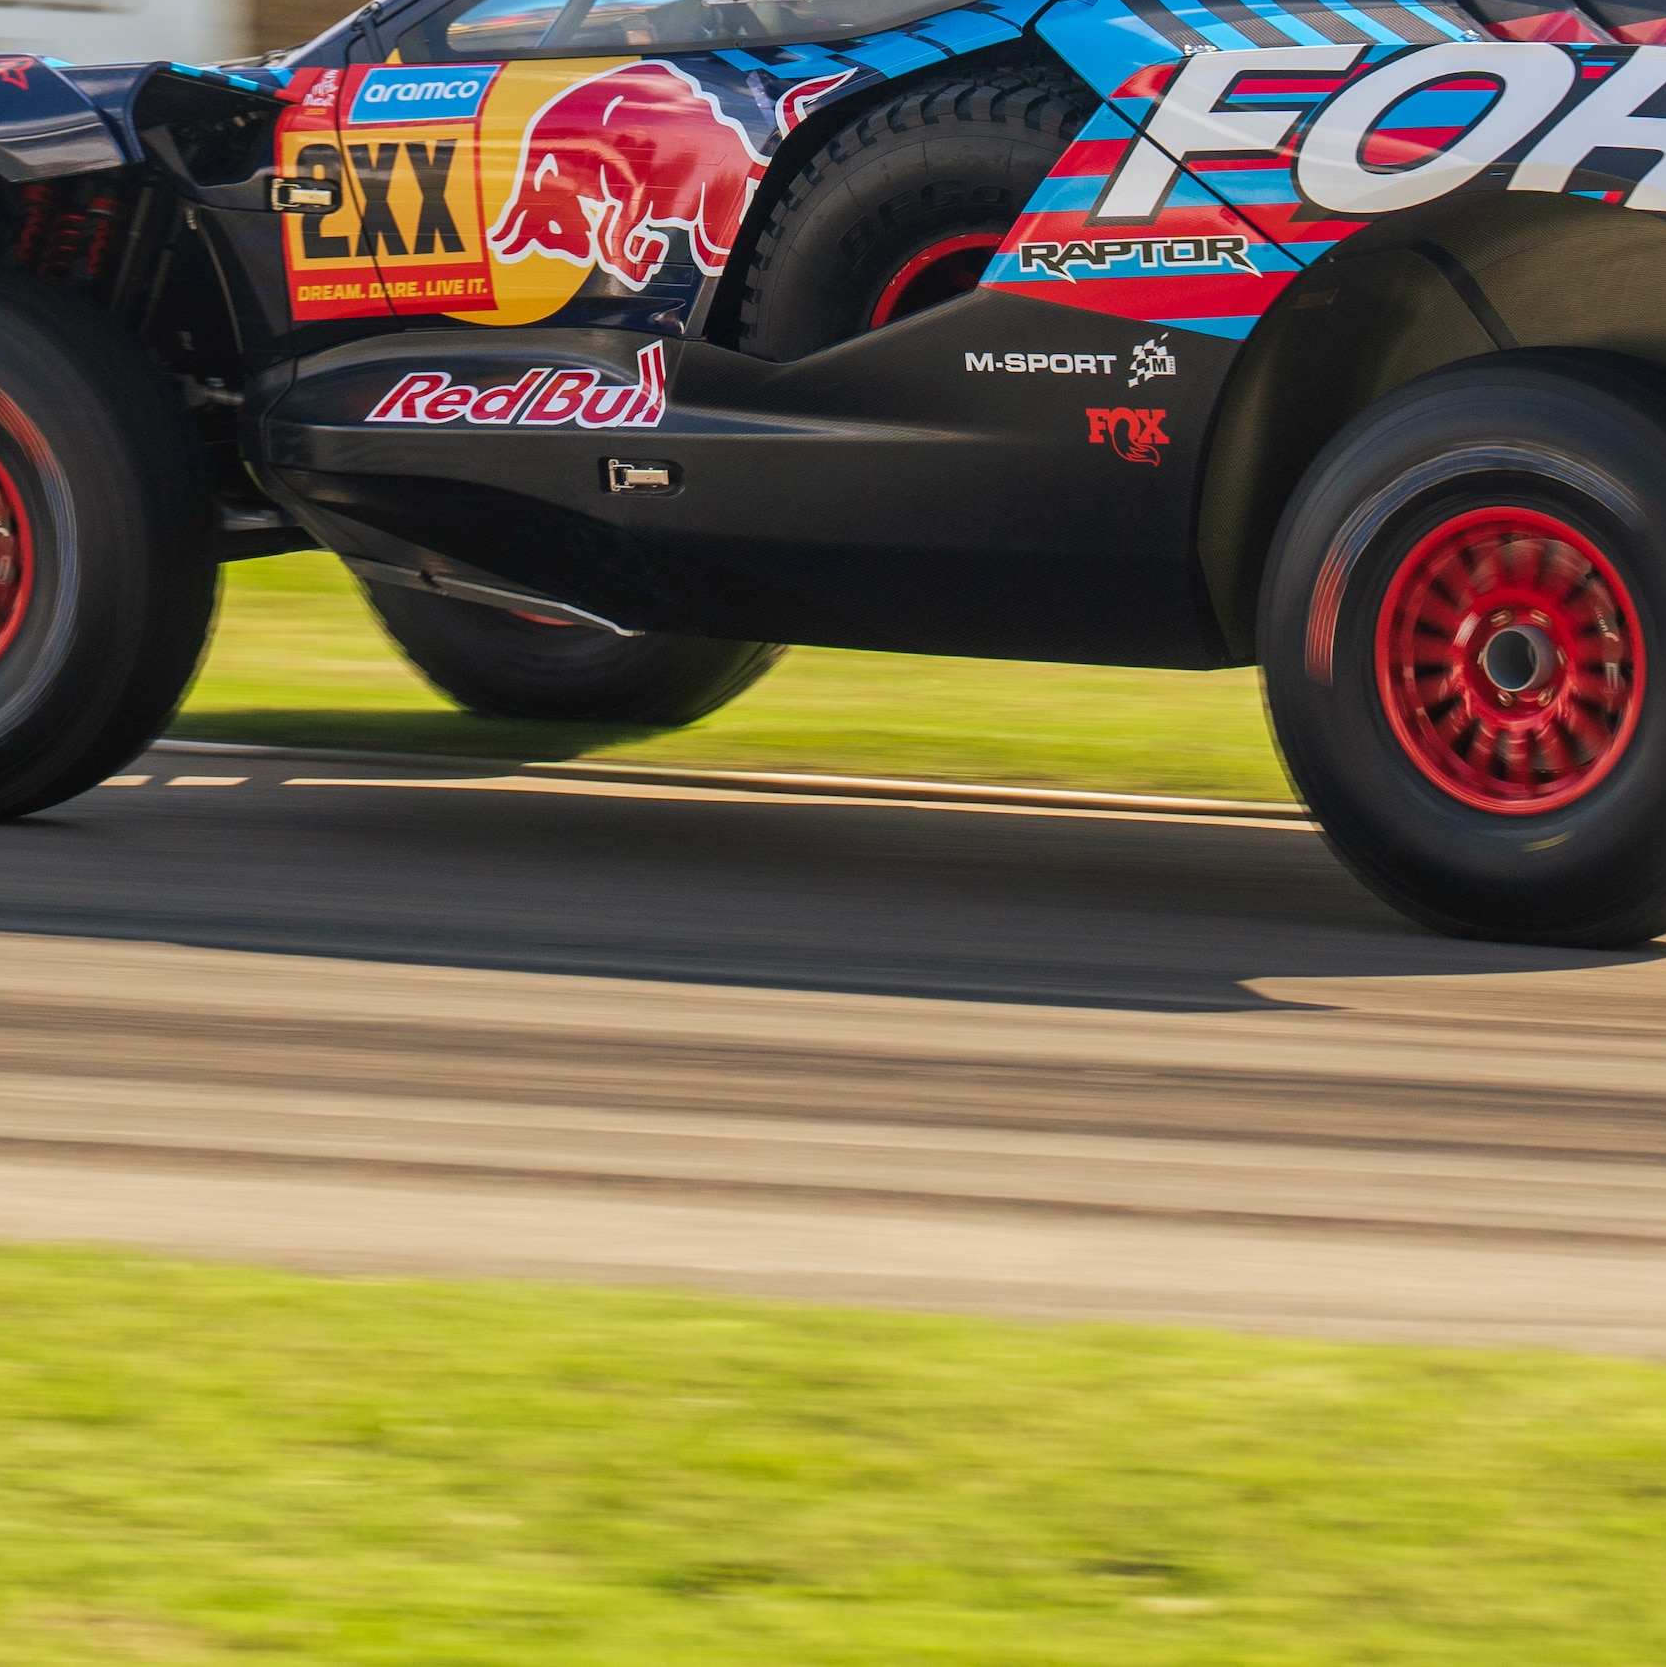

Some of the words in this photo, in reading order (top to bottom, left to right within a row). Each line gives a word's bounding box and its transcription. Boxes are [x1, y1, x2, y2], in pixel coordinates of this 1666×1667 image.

[364, 80, 480, 103] aramco
[296, 139, 466, 259] 2XX
[1019, 235, 1263, 284] RAPTOR
[297, 283, 366, 302] DREAM.
[369, 281, 423, 299] DARE.
[426, 278, 465, 296] LIVE
[467, 277, 488, 294] IT.
[964, 352, 1117, 374] M-SPORT
[1085, 407, 1170, 467] FOX
